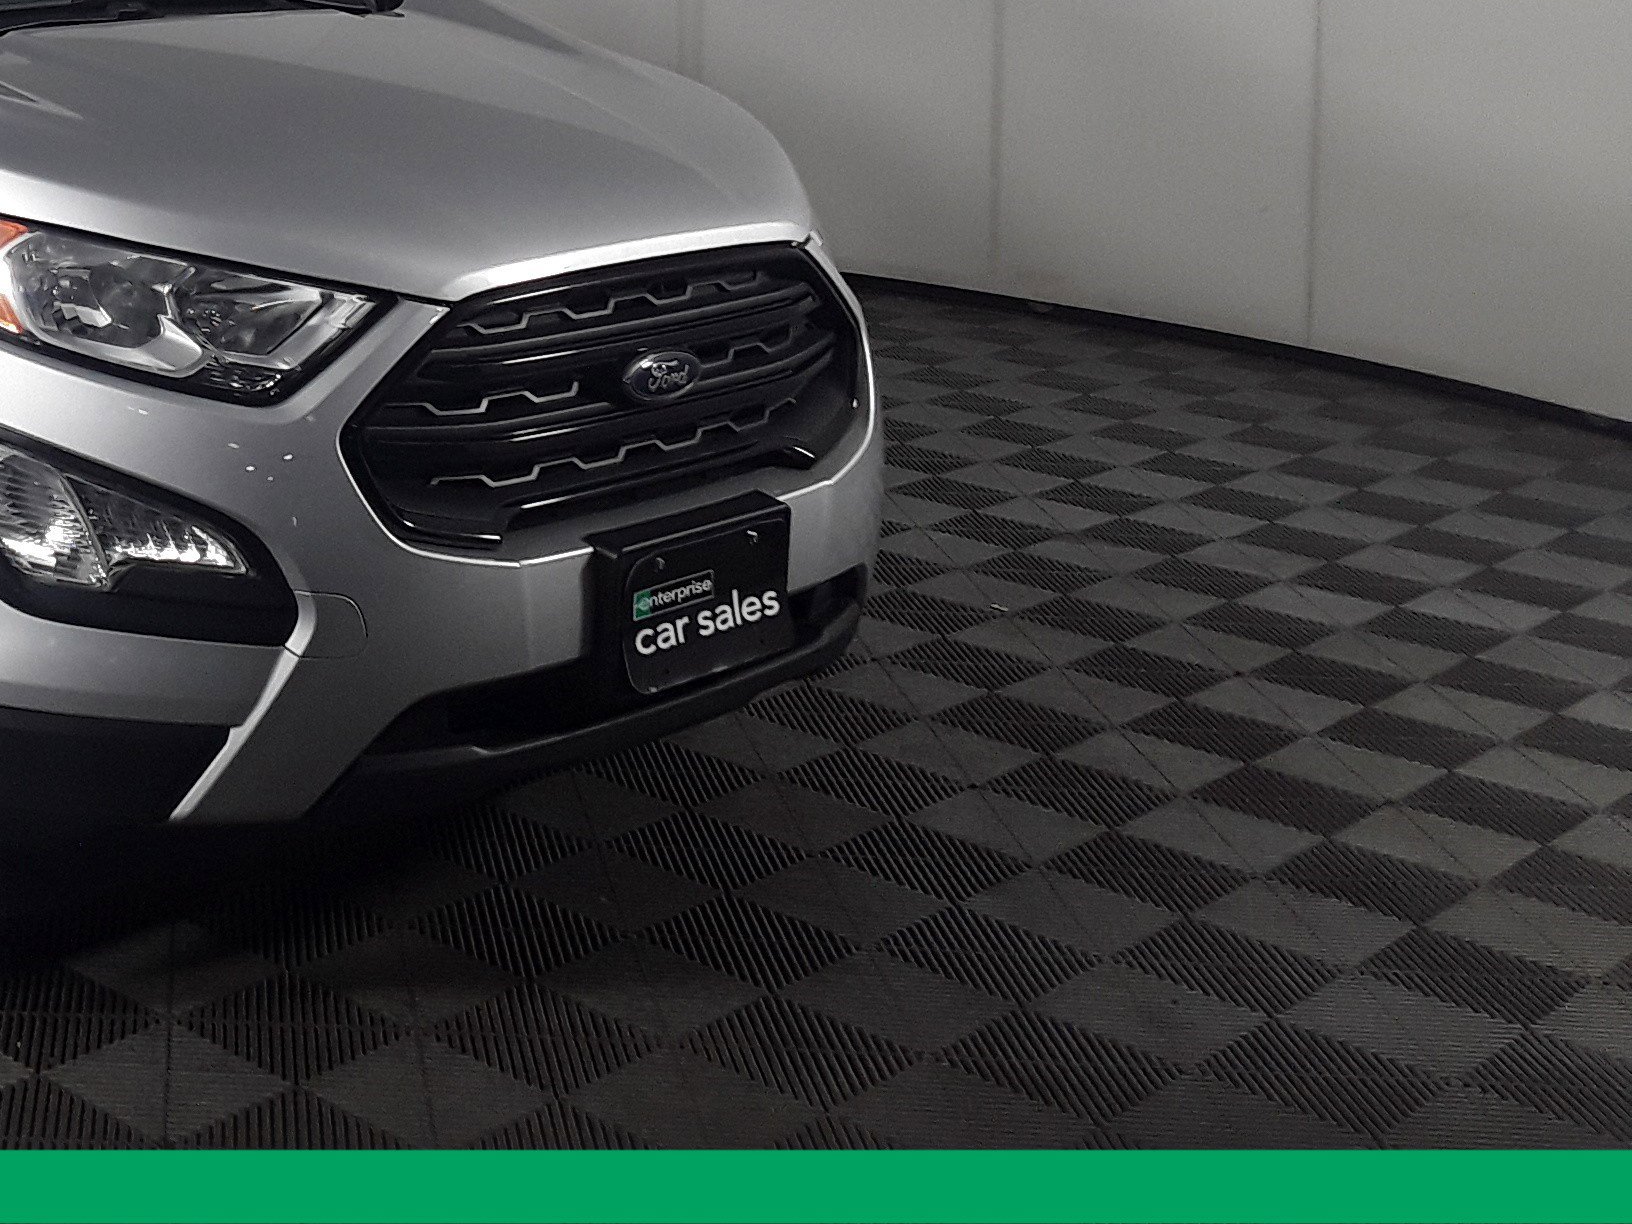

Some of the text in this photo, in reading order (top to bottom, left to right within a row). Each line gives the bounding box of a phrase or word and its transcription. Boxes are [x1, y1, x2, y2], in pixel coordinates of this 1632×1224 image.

[648, 360, 690, 393] Ford
[636, 579, 712, 611] enterprise
[634, 589, 780, 655] car sales
